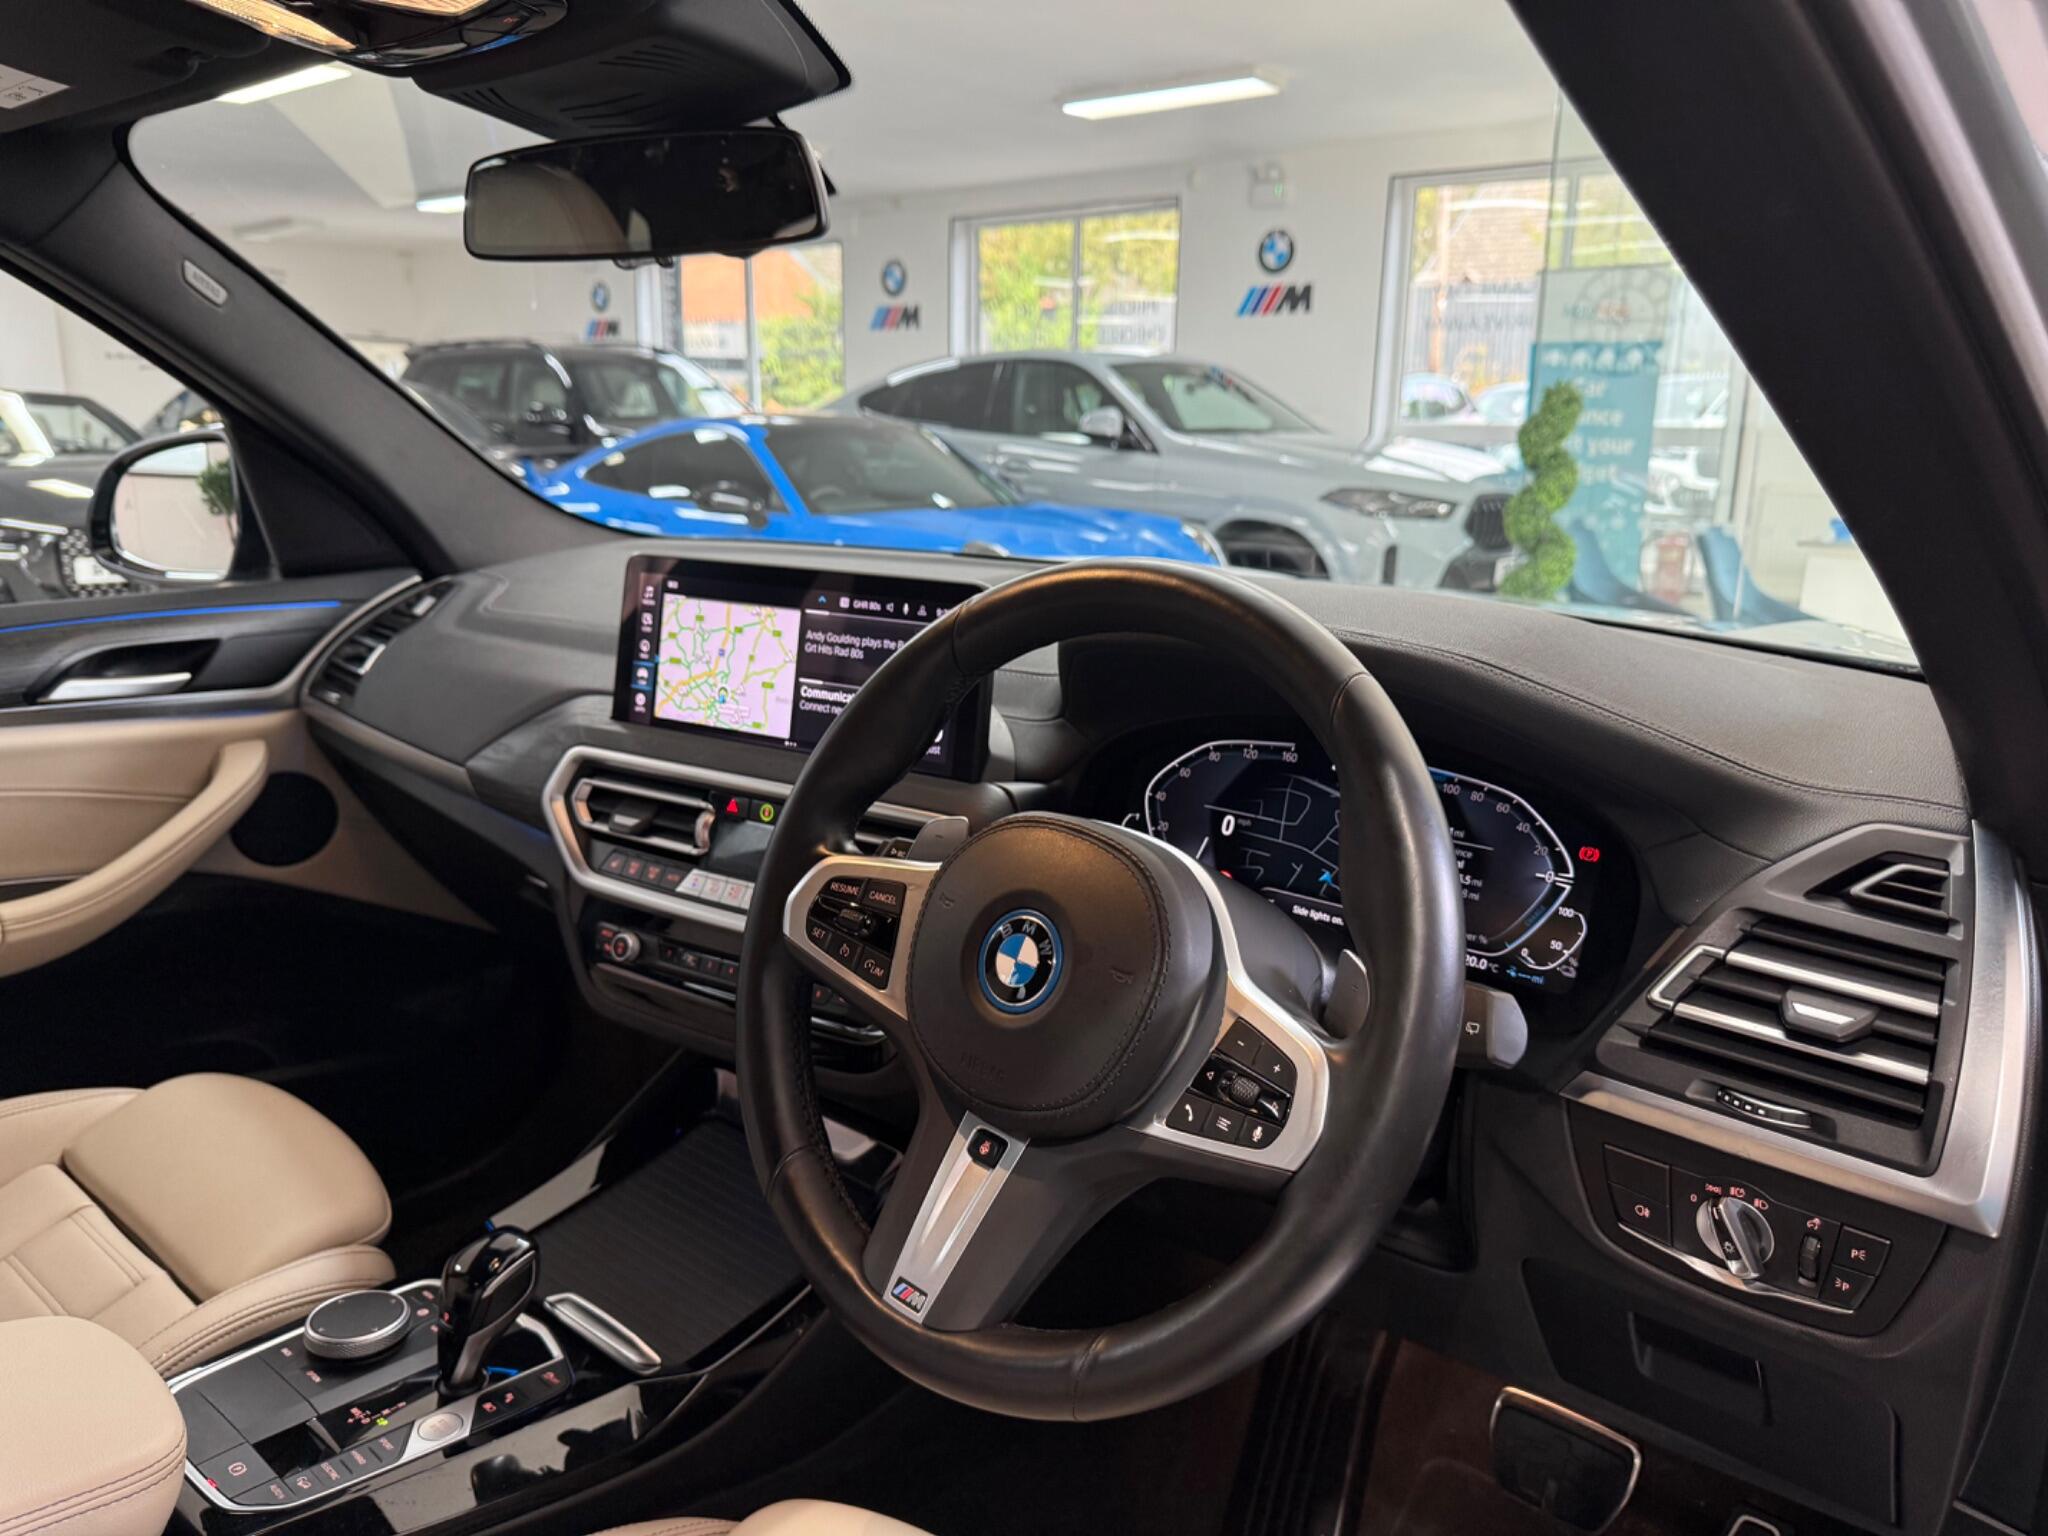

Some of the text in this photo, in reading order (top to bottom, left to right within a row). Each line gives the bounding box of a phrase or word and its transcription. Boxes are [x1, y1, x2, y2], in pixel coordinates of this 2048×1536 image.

[805, 630, 825, 643] Andy
[826, 632, 860, 647] Goulding
[861, 638, 882, 650] plays
[883, 640, 896, 649] the
[850, 648, 864, 659] 80s
[799, 700, 830, 713] Connect
[1208, 752, 1221, 763] 80
[1243, 749, 1258, 761] 120
[1282, 750, 1298, 763] 160
[1179, 768, 1191, 778] 60
[1442, 783, 1461, 795] 100
[1155, 791, 1167, 801] 40
[1470, 791, 1484, 802] 80
[1496, 803, 1510, 814] 60
[1157, 821, 1169, 832] 20
[1221, 815, 1235, 836] 0
[1516, 822, 1530, 833] 40
[1534, 845, 1548, 856] 20
[830, 882, 861, 896] RESUME
[869, 890, 896, 906] CANCEL
[1292, 905, 1308, 917] Side
[1309, 909, 1330, 922] lights
[1559, 906, 1574, 917] 100
[812, 927, 826, 939] SET
[1550, 940, 1563, 951] 50
